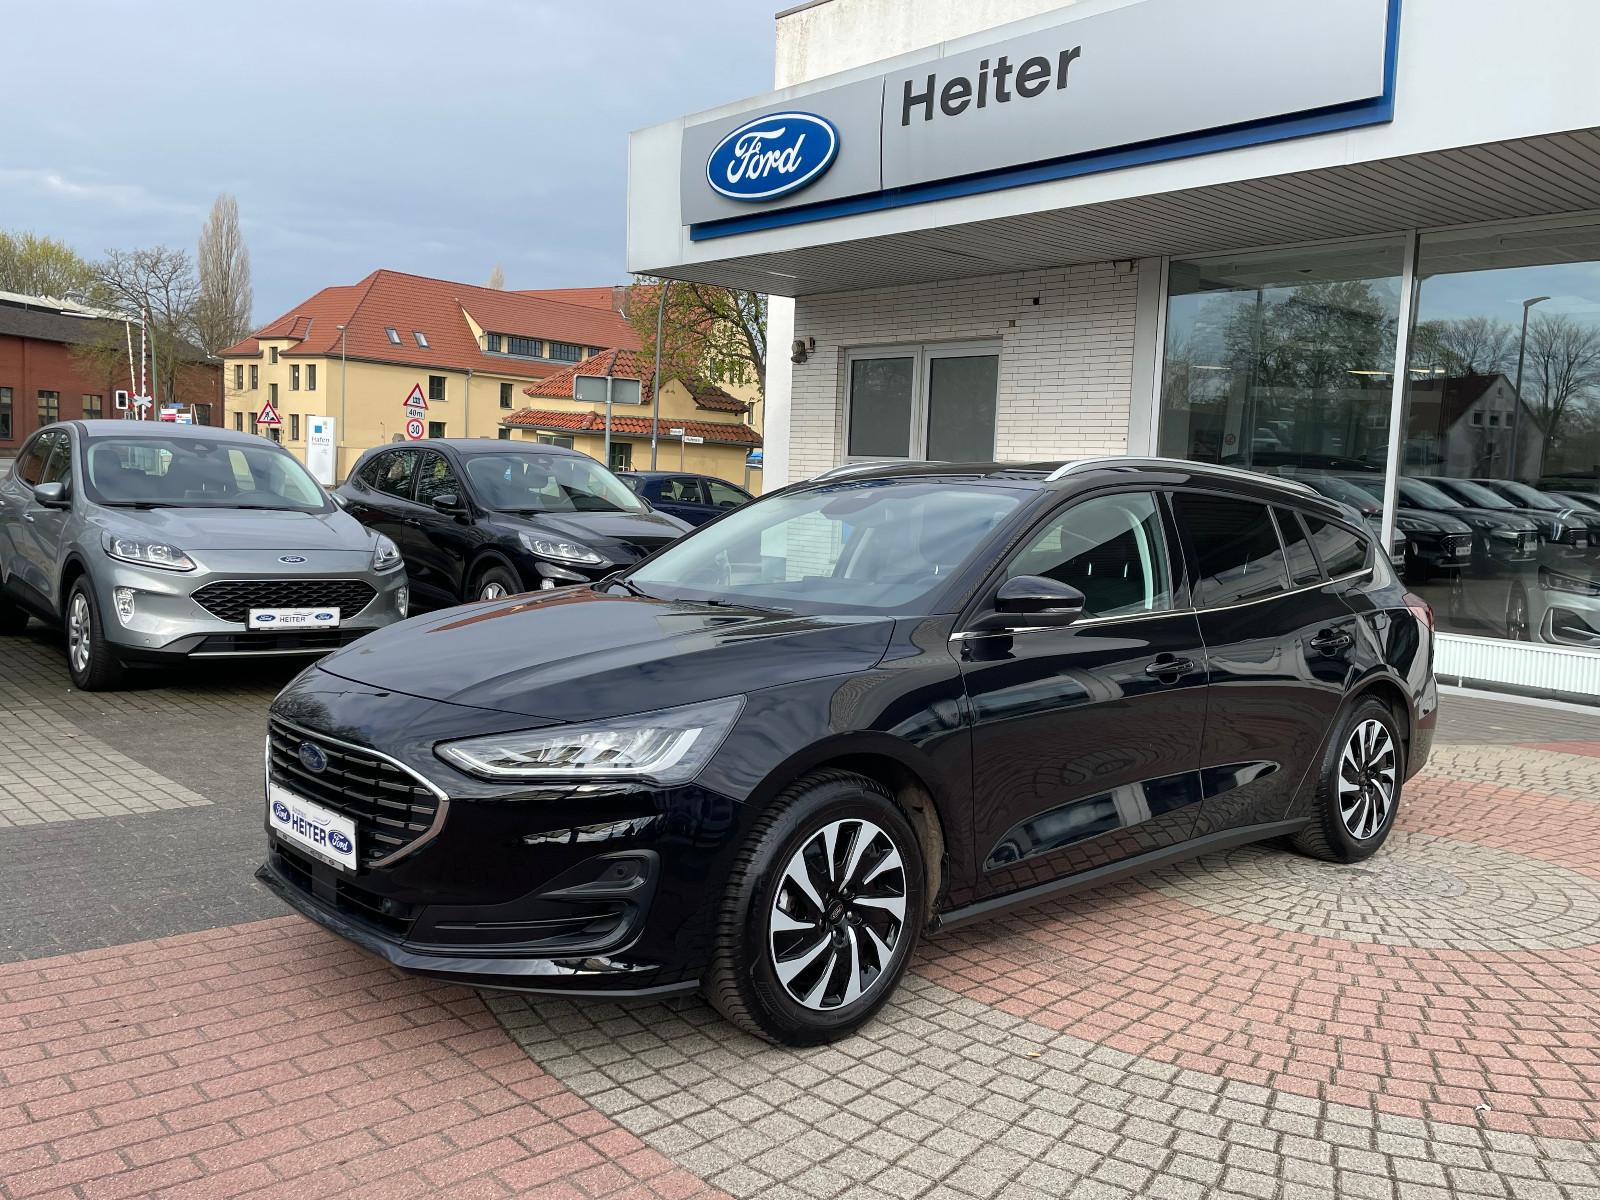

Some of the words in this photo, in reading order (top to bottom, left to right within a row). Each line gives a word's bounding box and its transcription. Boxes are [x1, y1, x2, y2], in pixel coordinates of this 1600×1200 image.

[901, 45, 1082, 127] Heiter
[726, 126, 803, 184] Ford
[410, 424, 420, 435] 30
[292, 813, 327, 847] HEITER
